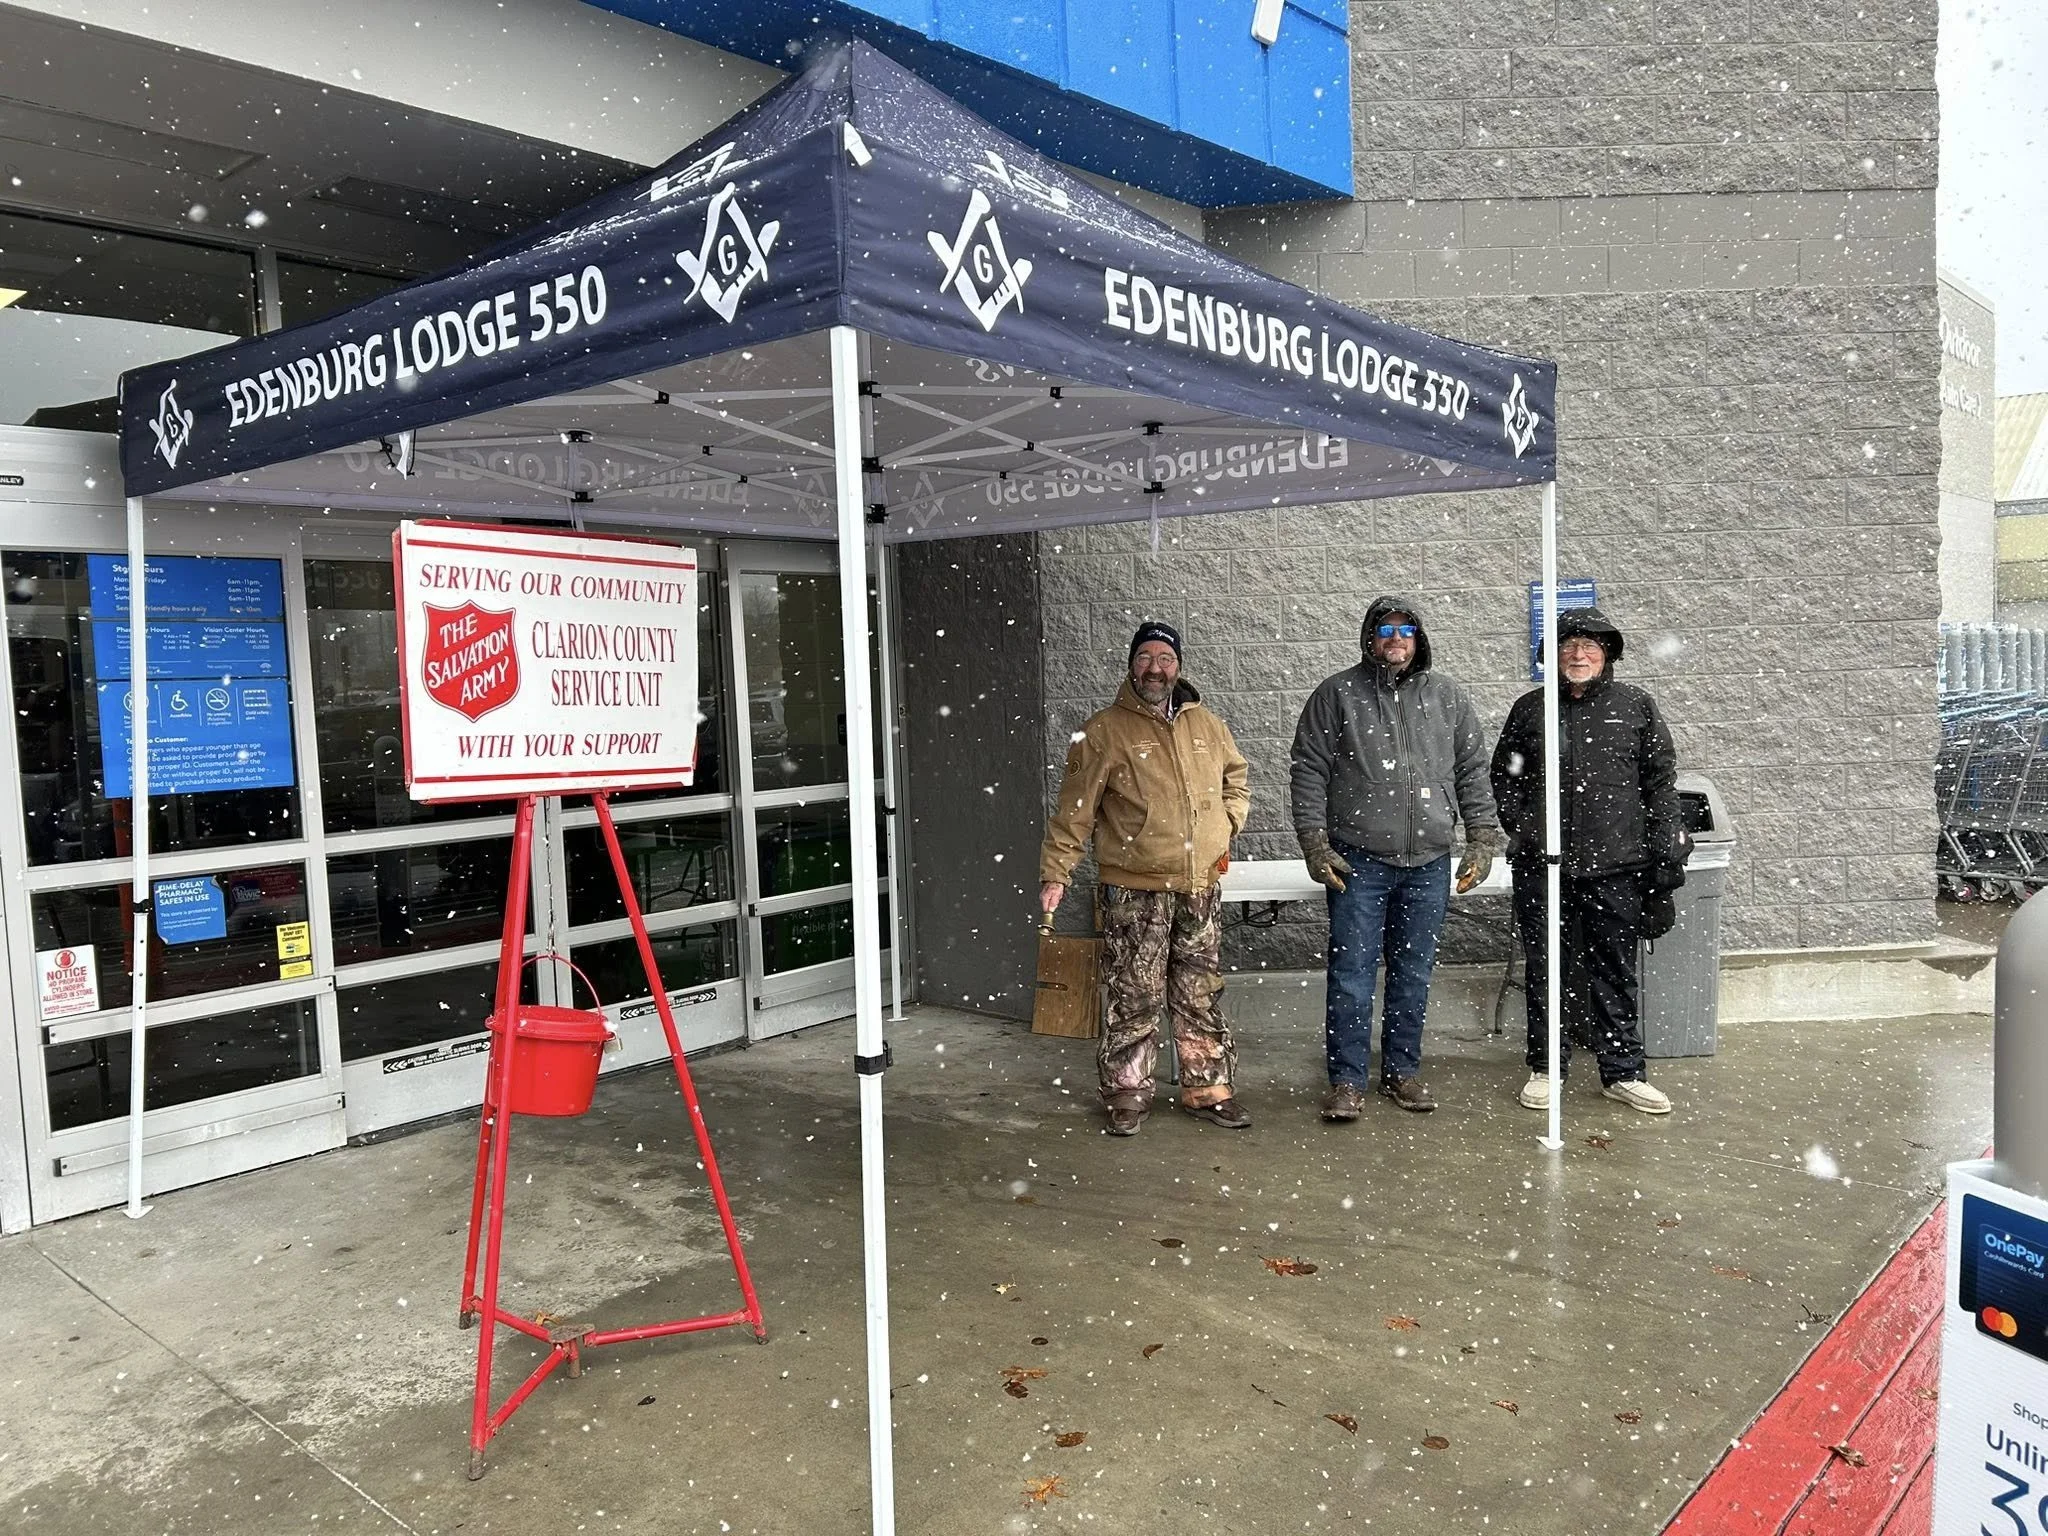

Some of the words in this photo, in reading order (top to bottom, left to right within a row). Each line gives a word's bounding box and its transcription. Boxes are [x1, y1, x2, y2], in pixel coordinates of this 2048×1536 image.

[718, 234, 738, 275] G
[973, 244, 993, 283] G
[225, 340, 388, 429] EDENBURG
[393, 290, 521, 380] LODGE
[530, 265, 608, 342] 550
[1104, 267, 1315, 377] EDENBURG
[1320, 326, 1417, 407] LODGE
[1422, 376, 1471, 421] 550
[144, 565, 165, 574] ours
[420, 563, 512, 593] SERVING
[521, 571, 562, 597] OUR
[570, 575, 687, 604] COMMUNITY
[439, 612, 478, 648] THE
[532, 621, 608, 661] CLARION
[613, 625, 678, 663] COUNTY
[427, 622, 510, 689] SALVATION
[460, 656, 510, 706] ARMY
[551, 669, 622, 707] SERVICE
[626, 672, 663, 707] UNIT
[155, 736, 188, 744] Customer:
[458, 734, 515, 759] WITH
[524, 734, 575, 757] YOUR
[582, 732, 662, 756] SUPPORT
[182, 746, 204, 754] appear
[205, 743, 232, 752] younger
[233, 742, 248, 750] than
[162, 754, 181, 762] asked
[192, 752, 216, 761] provide
[218, 751, 236, 760] proof
[157, 763, 180, 772] proper
[193, 760, 229, 768] Customers
[231, 758, 248, 766] under
[171, 770, 198, 778] without
[199, 769, 221, 778] proper
[174, 778, 204, 787] purchase
[160, 888, 203, 898] PHARMACY
[160, 896, 183, 906] SAFES
[195, 893, 210, 902] USE
[46, 966, 87, 980] NOTICE
[59, 976, 86, 986] PROPANE
[52, 983, 85, 994] CYLINDERS
[43, 992, 68, 1002] ALLOWED
[1984, 1233, 2044, 1269] OnePay
[2027, 1267, 2045, 1279] Card
